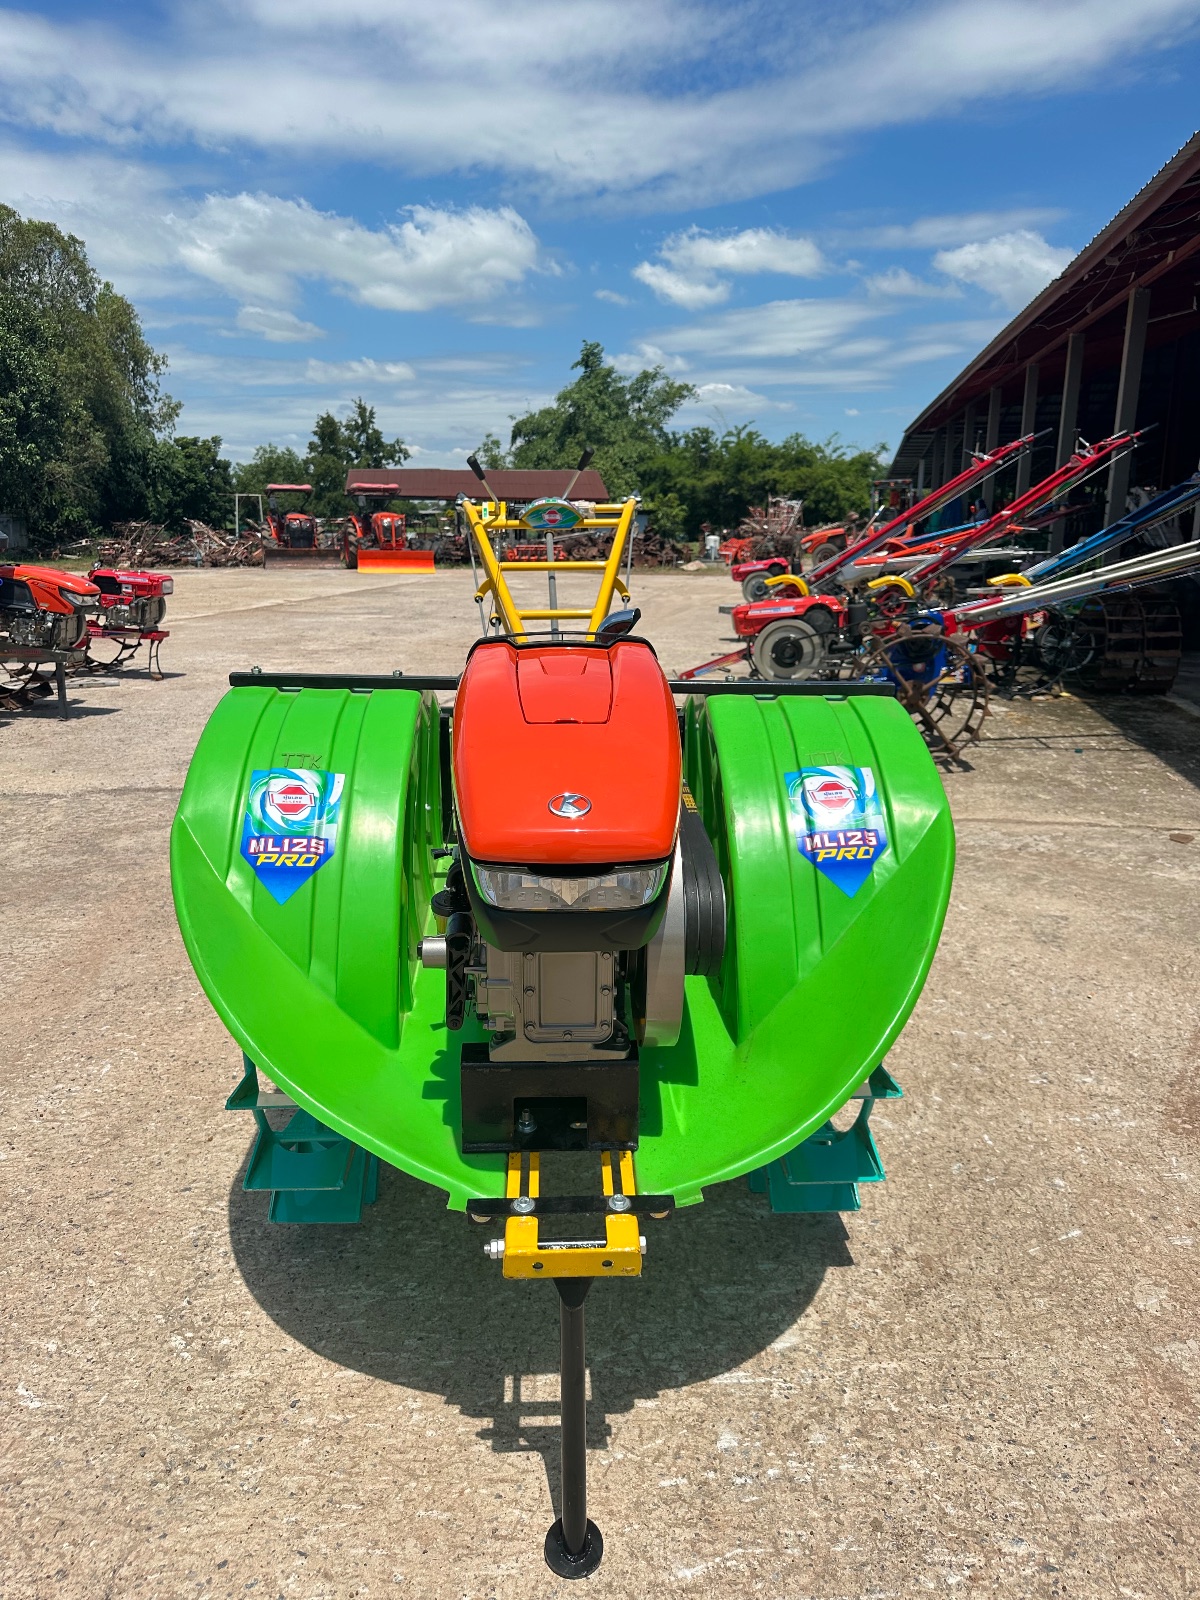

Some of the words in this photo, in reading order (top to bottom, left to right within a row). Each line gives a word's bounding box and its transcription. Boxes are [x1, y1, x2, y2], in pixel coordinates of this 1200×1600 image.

[281, 753, 323, 769] TTK
[248, 837, 325, 855] ML125
[805, 830, 878, 852] ML125
[256, 853, 320, 867] PRO
[816, 846, 875, 862] PRO
